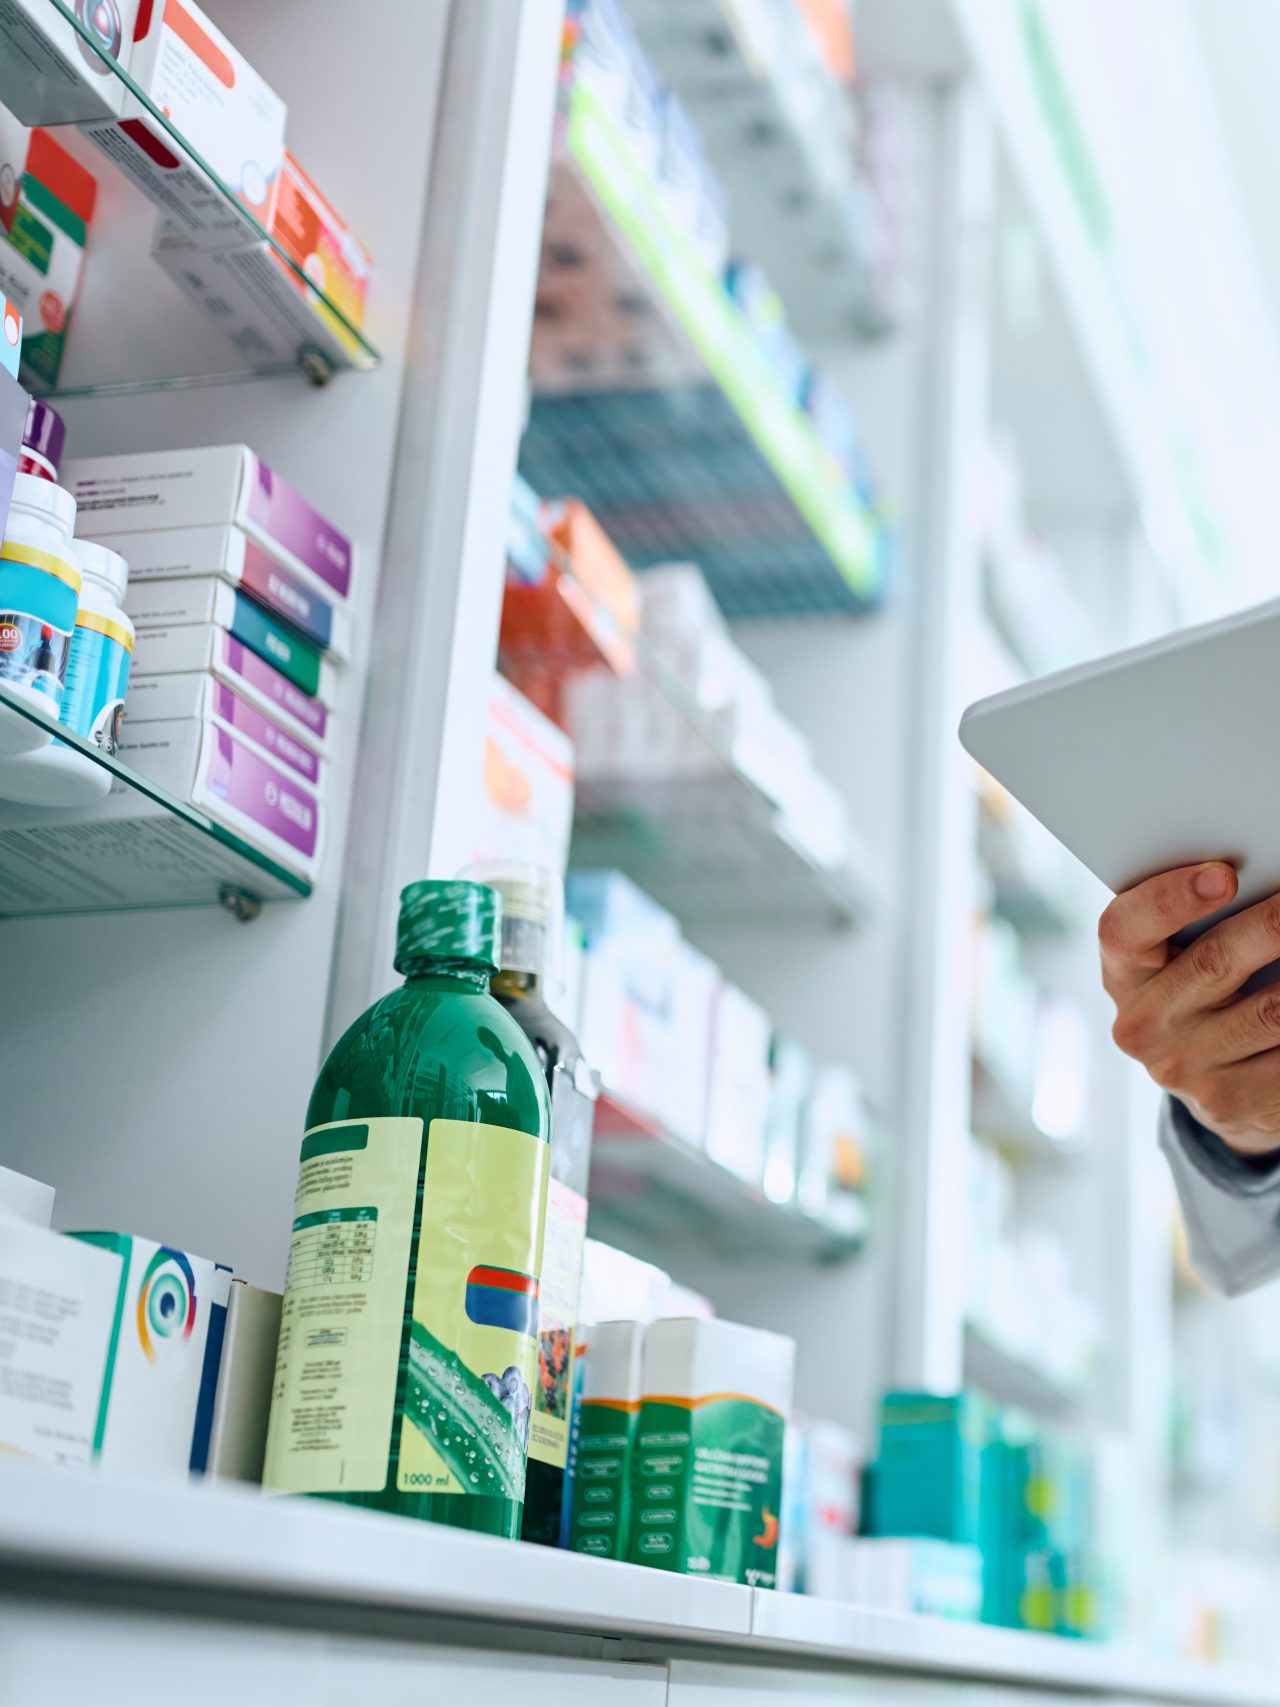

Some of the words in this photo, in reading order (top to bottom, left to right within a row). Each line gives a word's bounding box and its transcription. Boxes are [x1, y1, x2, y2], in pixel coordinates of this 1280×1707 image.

[0, 628, 17, 639] 00
[404, 1473, 432, 1484] 1000
[435, 1473, 449, 1485] ml
